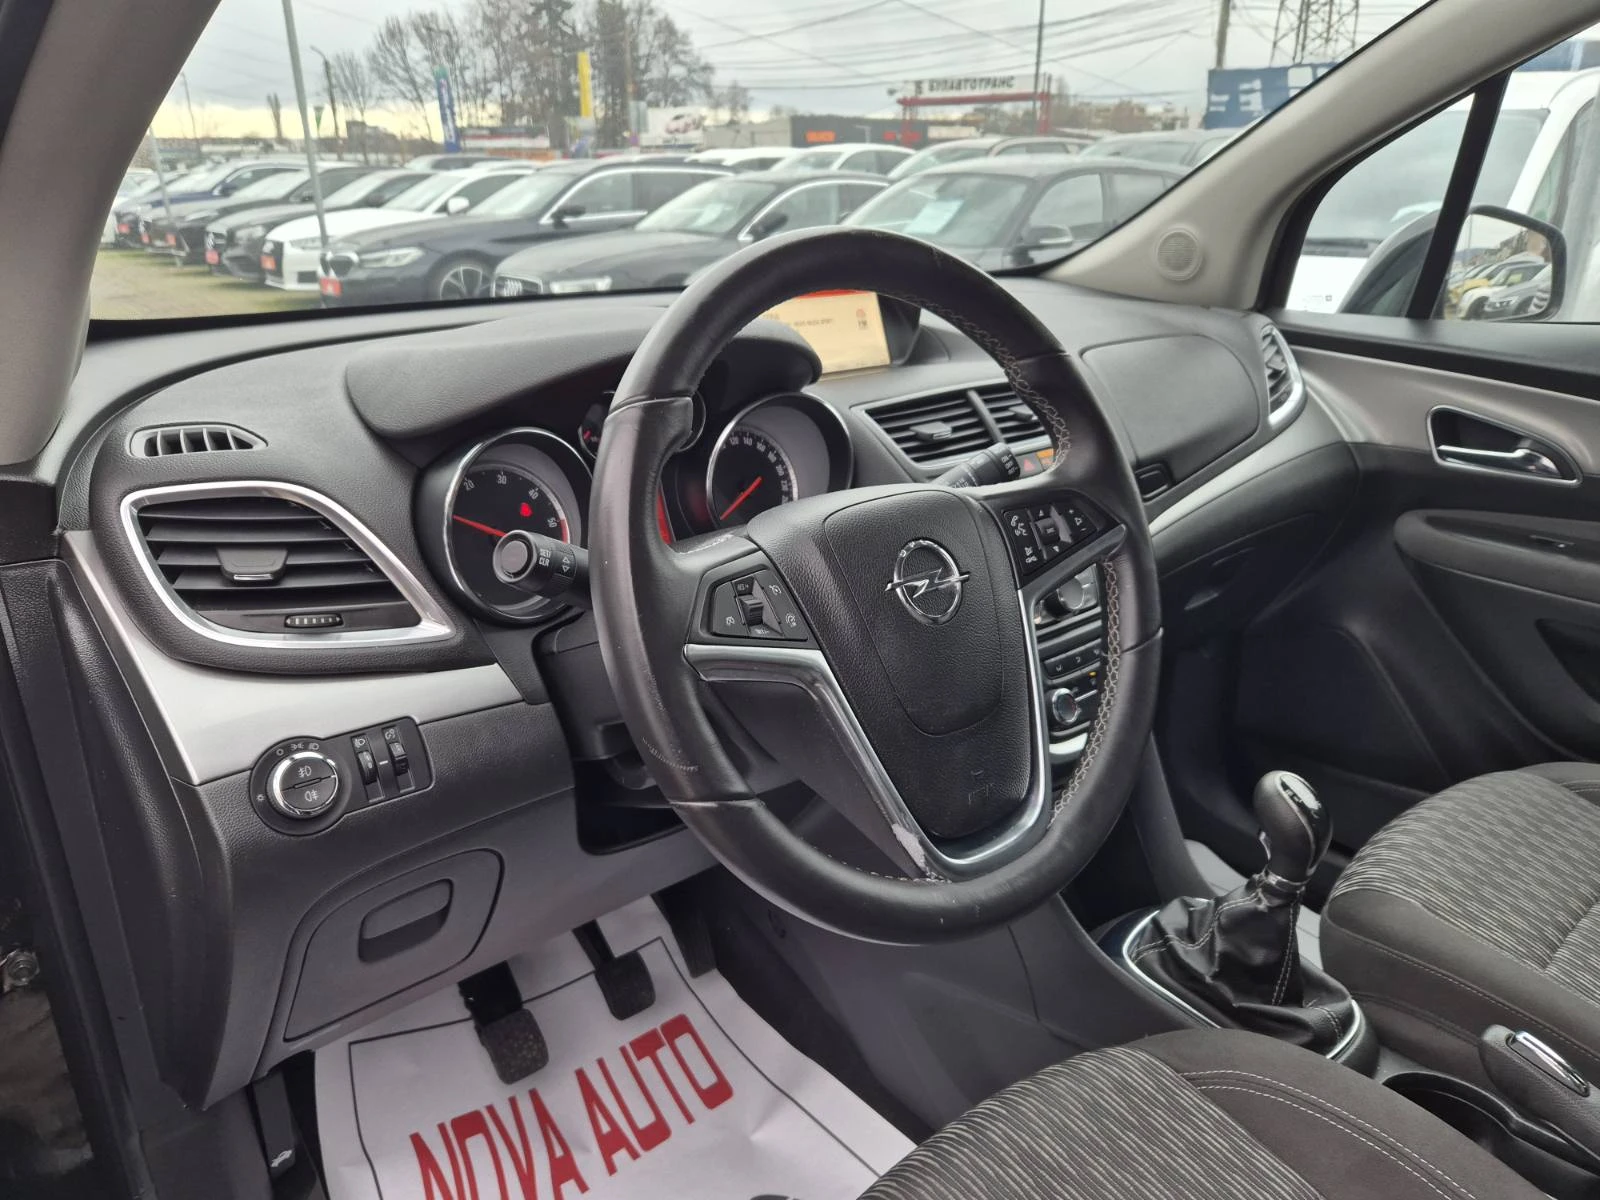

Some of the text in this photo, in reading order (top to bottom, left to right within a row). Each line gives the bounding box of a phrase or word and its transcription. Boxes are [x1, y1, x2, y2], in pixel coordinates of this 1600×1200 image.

[463, 480, 475, 490] 20
[497, 474, 507, 485] 30
[528, 489, 539, 500] 40
[547, 517, 558, 528] 50
[539, 557, 550, 568] CLR
[409, 1013, 734, 1200] NOVA AUTO
